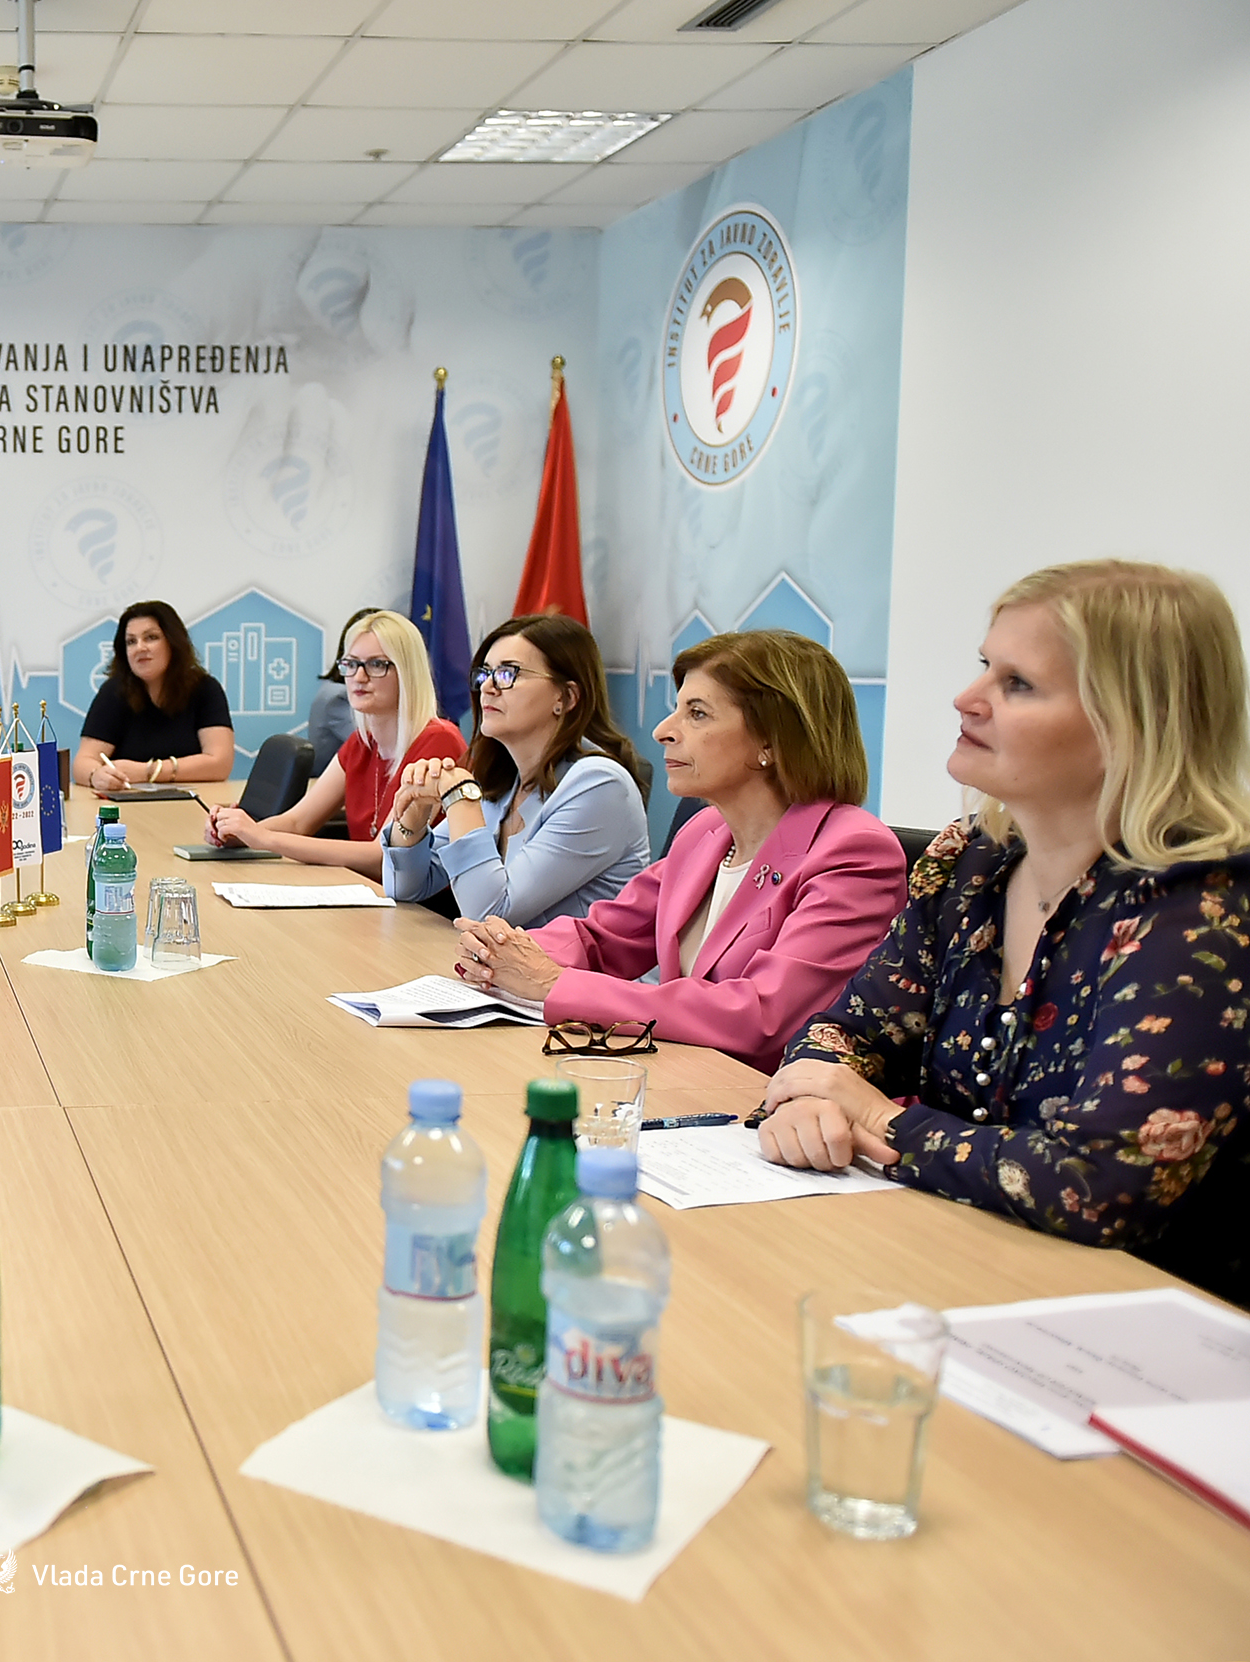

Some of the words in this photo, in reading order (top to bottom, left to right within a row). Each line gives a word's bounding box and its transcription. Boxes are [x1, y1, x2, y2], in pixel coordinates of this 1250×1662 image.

[667, 265, 700, 368] INSTITUT
[699, 239, 717, 266] ZA
[719, 221, 758, 249] JAVNO
[756, 231, 792, 335] ZDRAVLJE
[82, 343, 89, 372] I
[103, 343, 290, 375] UNAPREĐENJA
[25, 379, 221, 414] STANOVNIŠTVA
[57, 425, 126, 454] GORE
[689, 446, 718, 475] CRNE
[723, 433, 755, 475] GORE
[564, 1338, 653, 1384] diva
